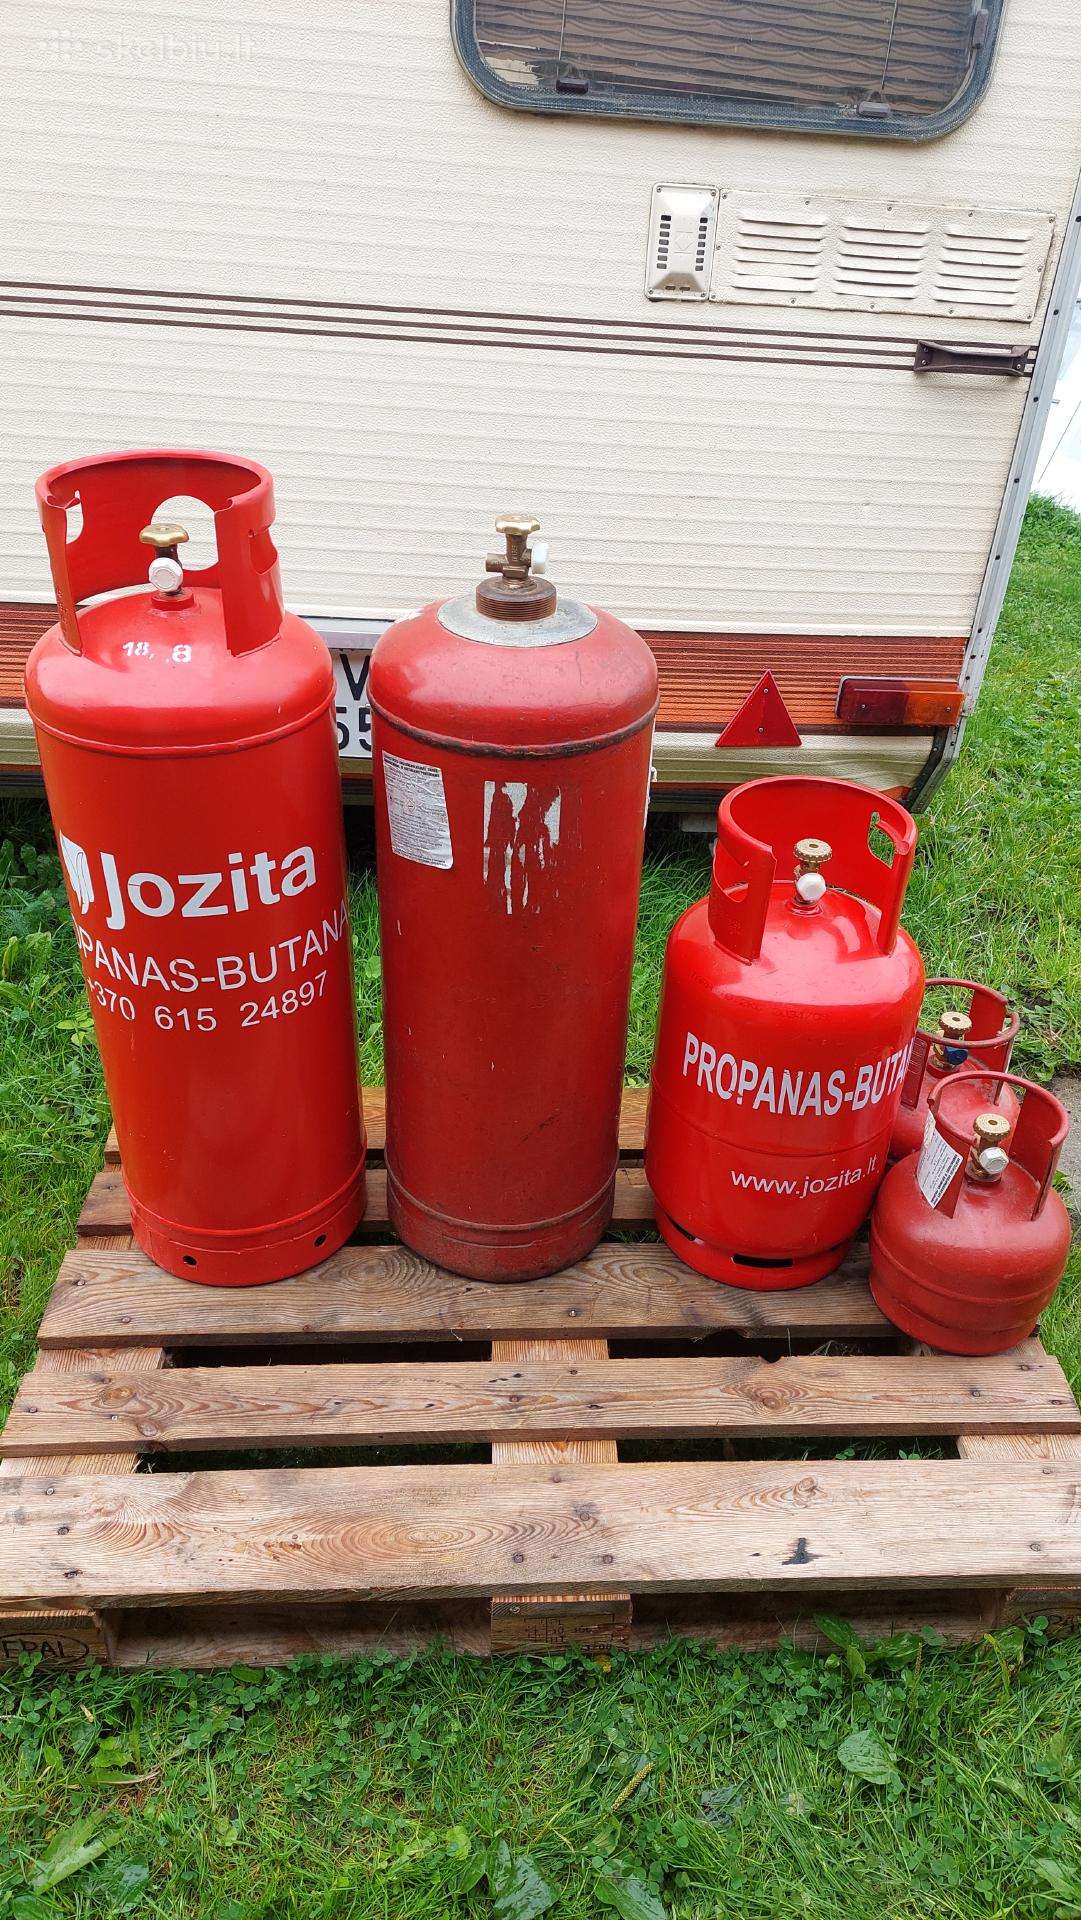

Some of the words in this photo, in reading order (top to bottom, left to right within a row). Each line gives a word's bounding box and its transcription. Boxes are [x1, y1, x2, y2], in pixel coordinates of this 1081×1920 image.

[340, 653, 371, 701] V
[100, 846, 318, 930] Jozita
[71, 900, 348, 993] PANAS-BUTANA
[154, 1005, 217, 1032] 615
[239, 970, 327, 1028] 24897
[731, 1153, 877, 1199] www.jozita.lt
[2, 1638, 75, 1663] EPAL
